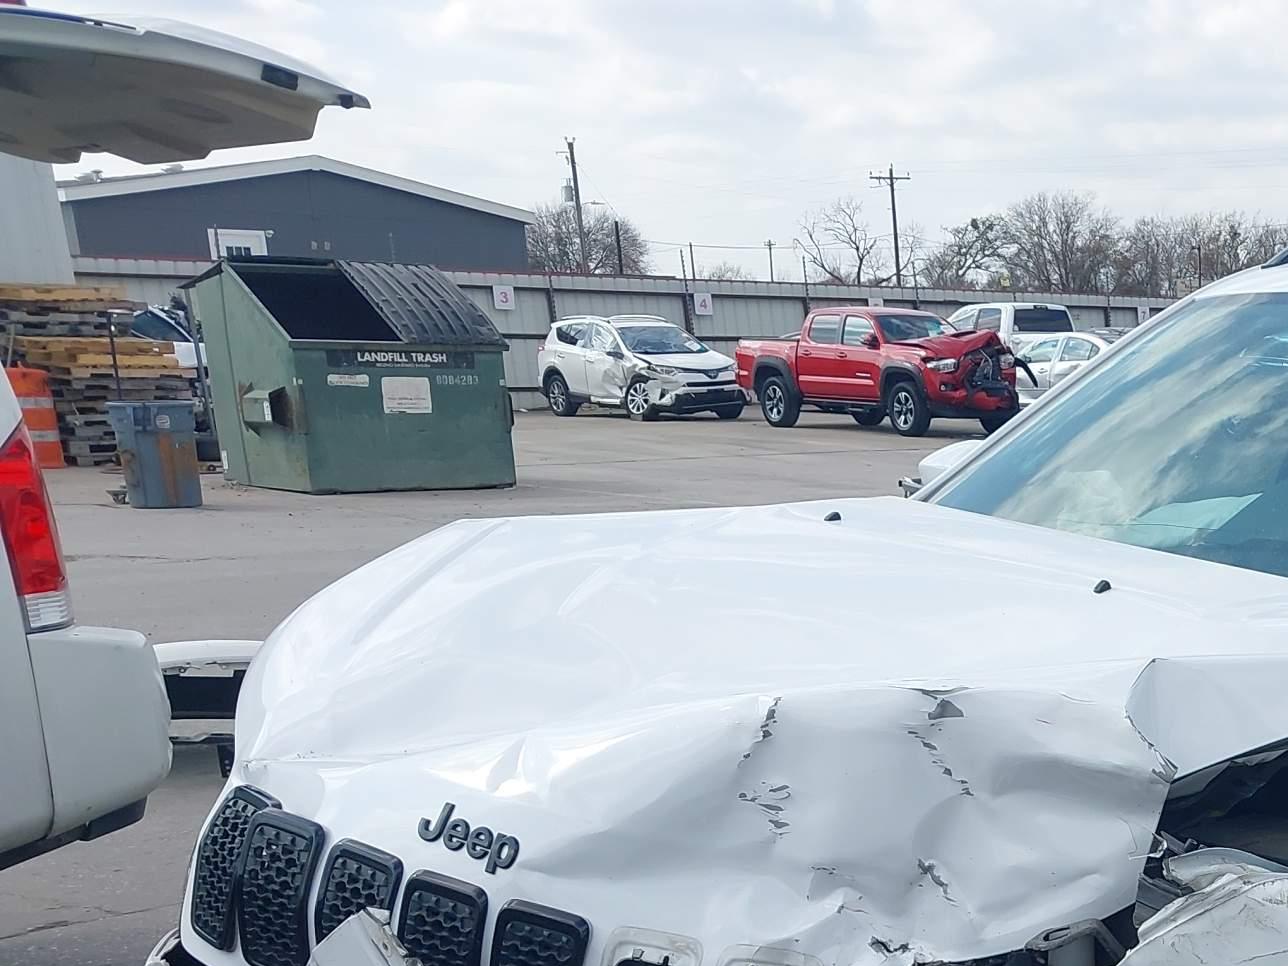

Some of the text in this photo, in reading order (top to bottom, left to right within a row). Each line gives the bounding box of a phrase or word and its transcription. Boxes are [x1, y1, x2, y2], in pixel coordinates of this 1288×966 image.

[499, 290, 509, 304] 3
[699, 297, 708, 310] 4
[356, 351, 447, 363] LANDFILL TRASH
[417, 801, 520, 875] Jeep
